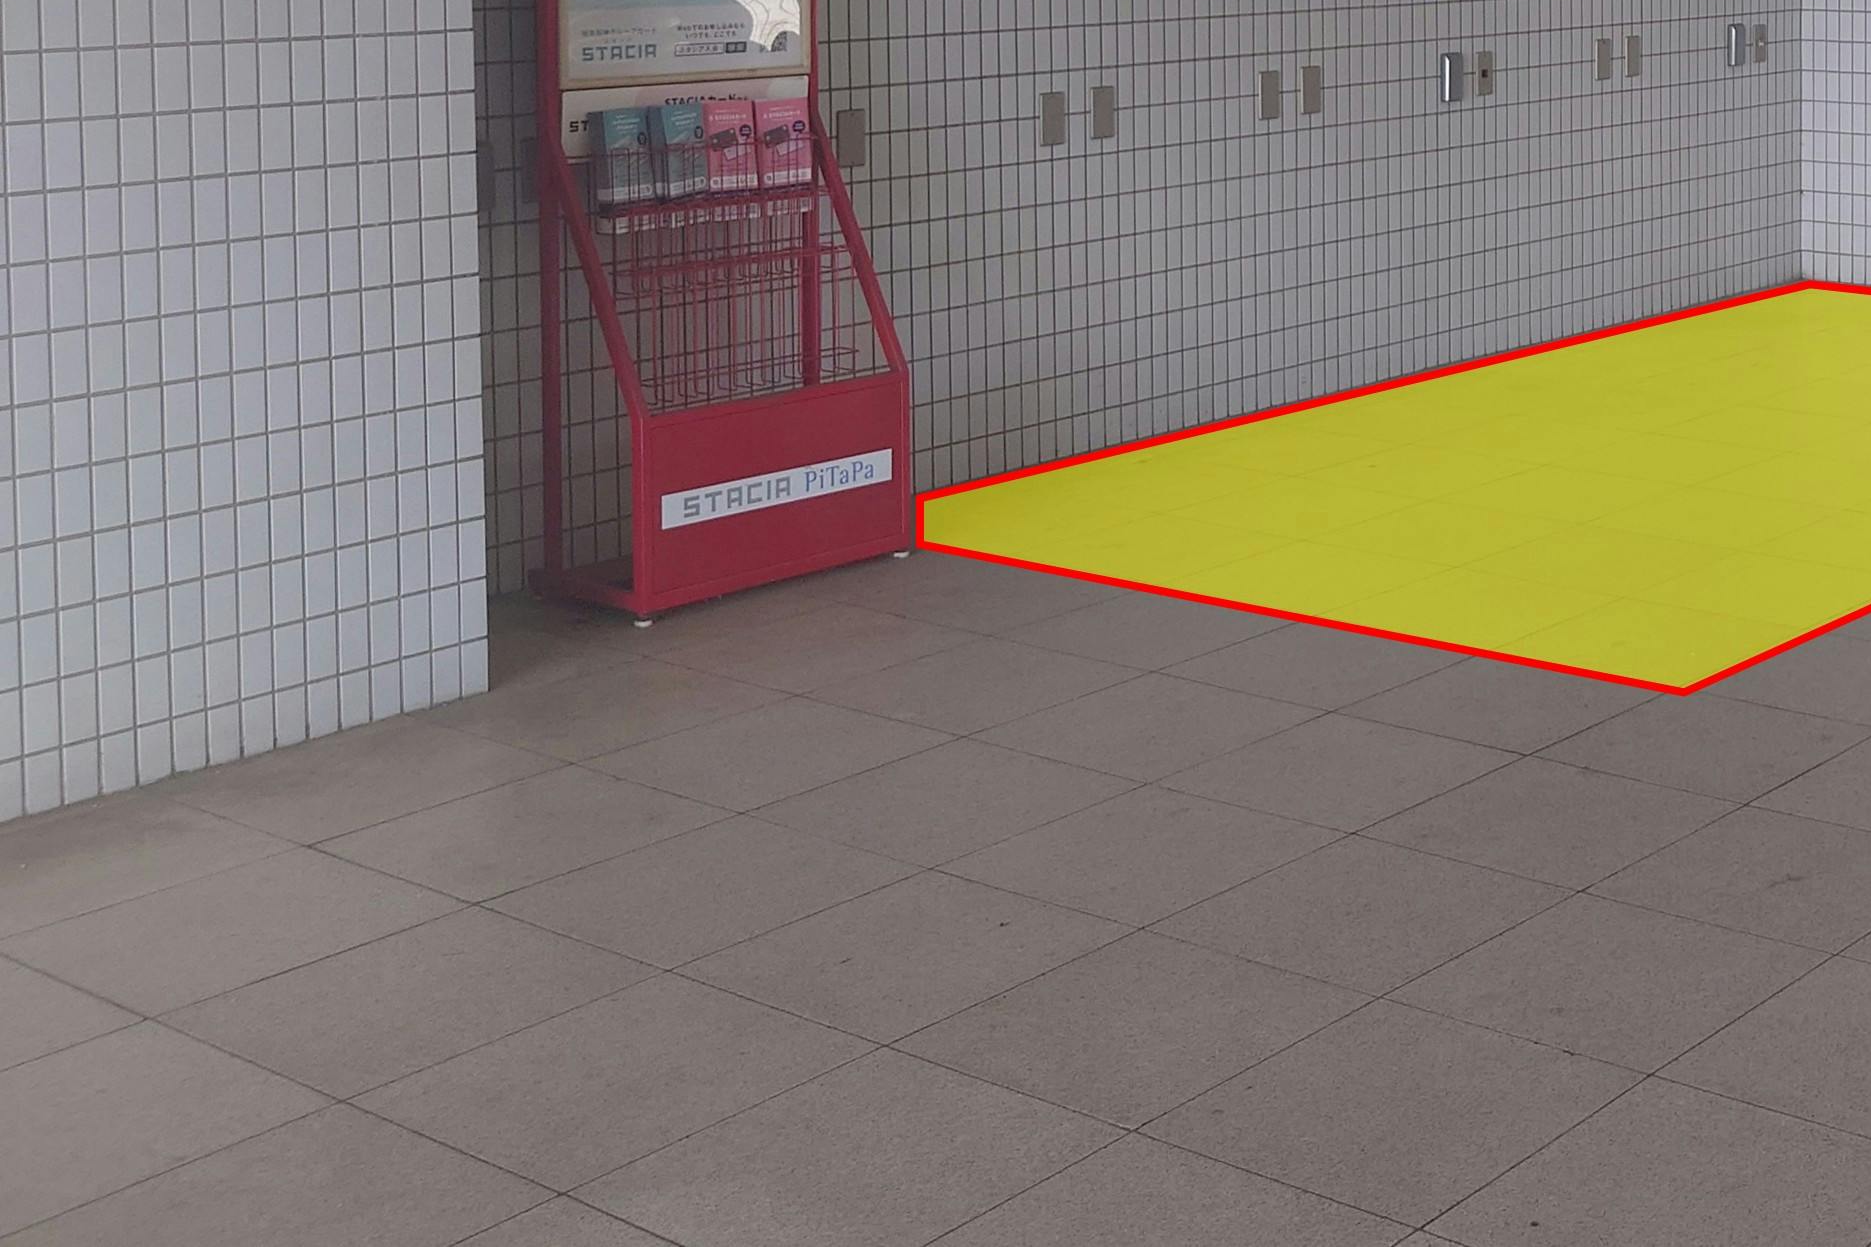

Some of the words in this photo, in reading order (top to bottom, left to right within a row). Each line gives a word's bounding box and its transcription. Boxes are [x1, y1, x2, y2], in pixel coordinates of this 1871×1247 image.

[581, 43, 658, 62] STACIA
[683, 476, 792, 519] STACIA
[805, 460, 875, 493] PiTaPa
